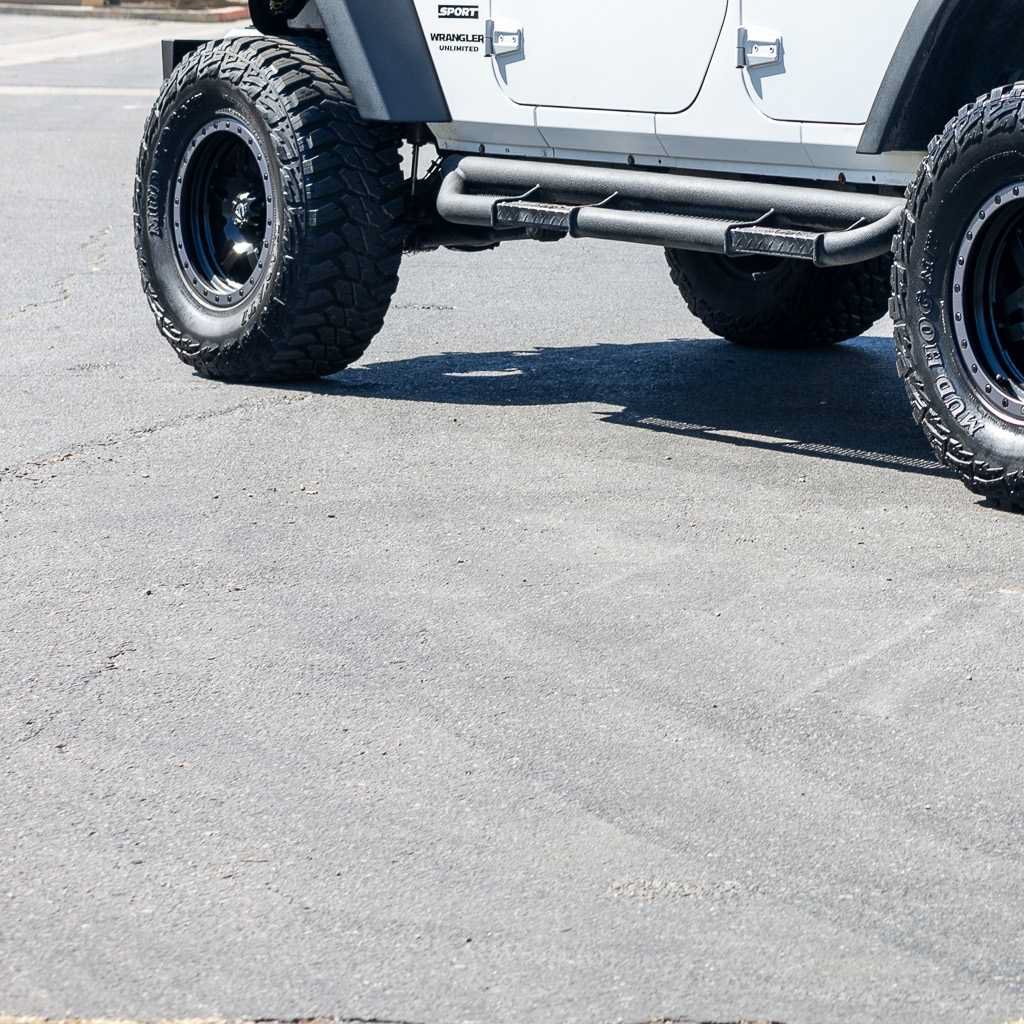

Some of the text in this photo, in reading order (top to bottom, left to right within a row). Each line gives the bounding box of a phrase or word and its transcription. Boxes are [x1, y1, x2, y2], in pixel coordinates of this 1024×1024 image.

[438, 6, 478, 18] SPORT
[430, 33, 484, 43] WRANGLER
[439, 45, 479, 53] UNLIMITED
[935, 375, 985, 438] MUD
